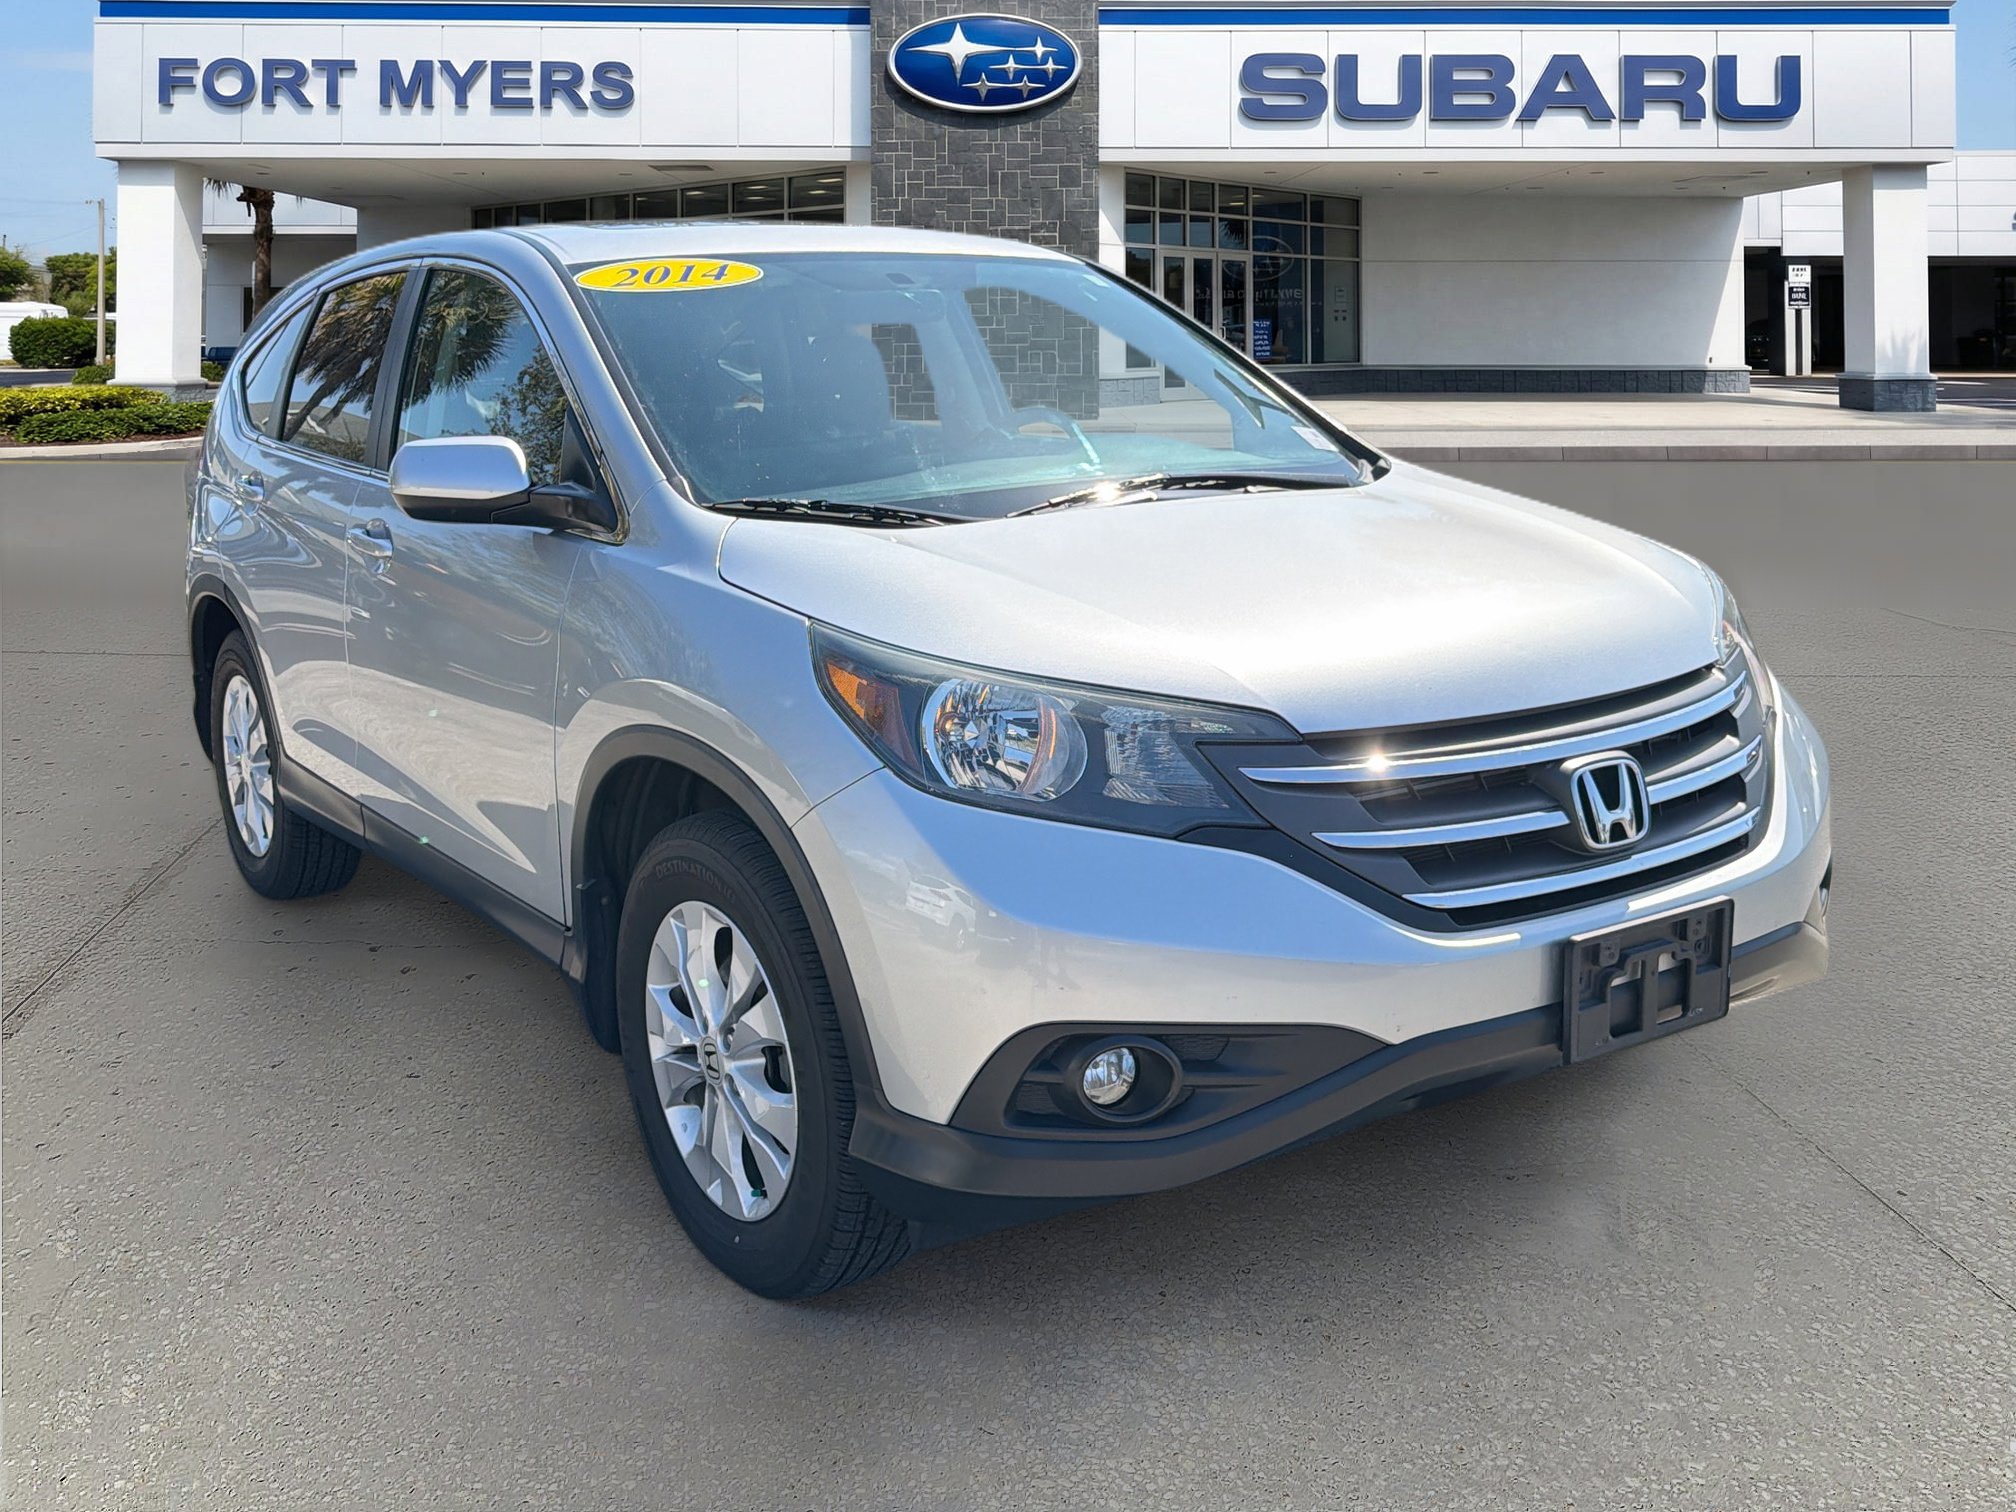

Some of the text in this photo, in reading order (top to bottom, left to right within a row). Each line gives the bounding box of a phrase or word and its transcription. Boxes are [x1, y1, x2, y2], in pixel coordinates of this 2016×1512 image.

[158, 57, 635, 110] FORT MYERS
[1239, 52, 1802, 122] SUBARU
[611, 263, 730, 288] 2014
